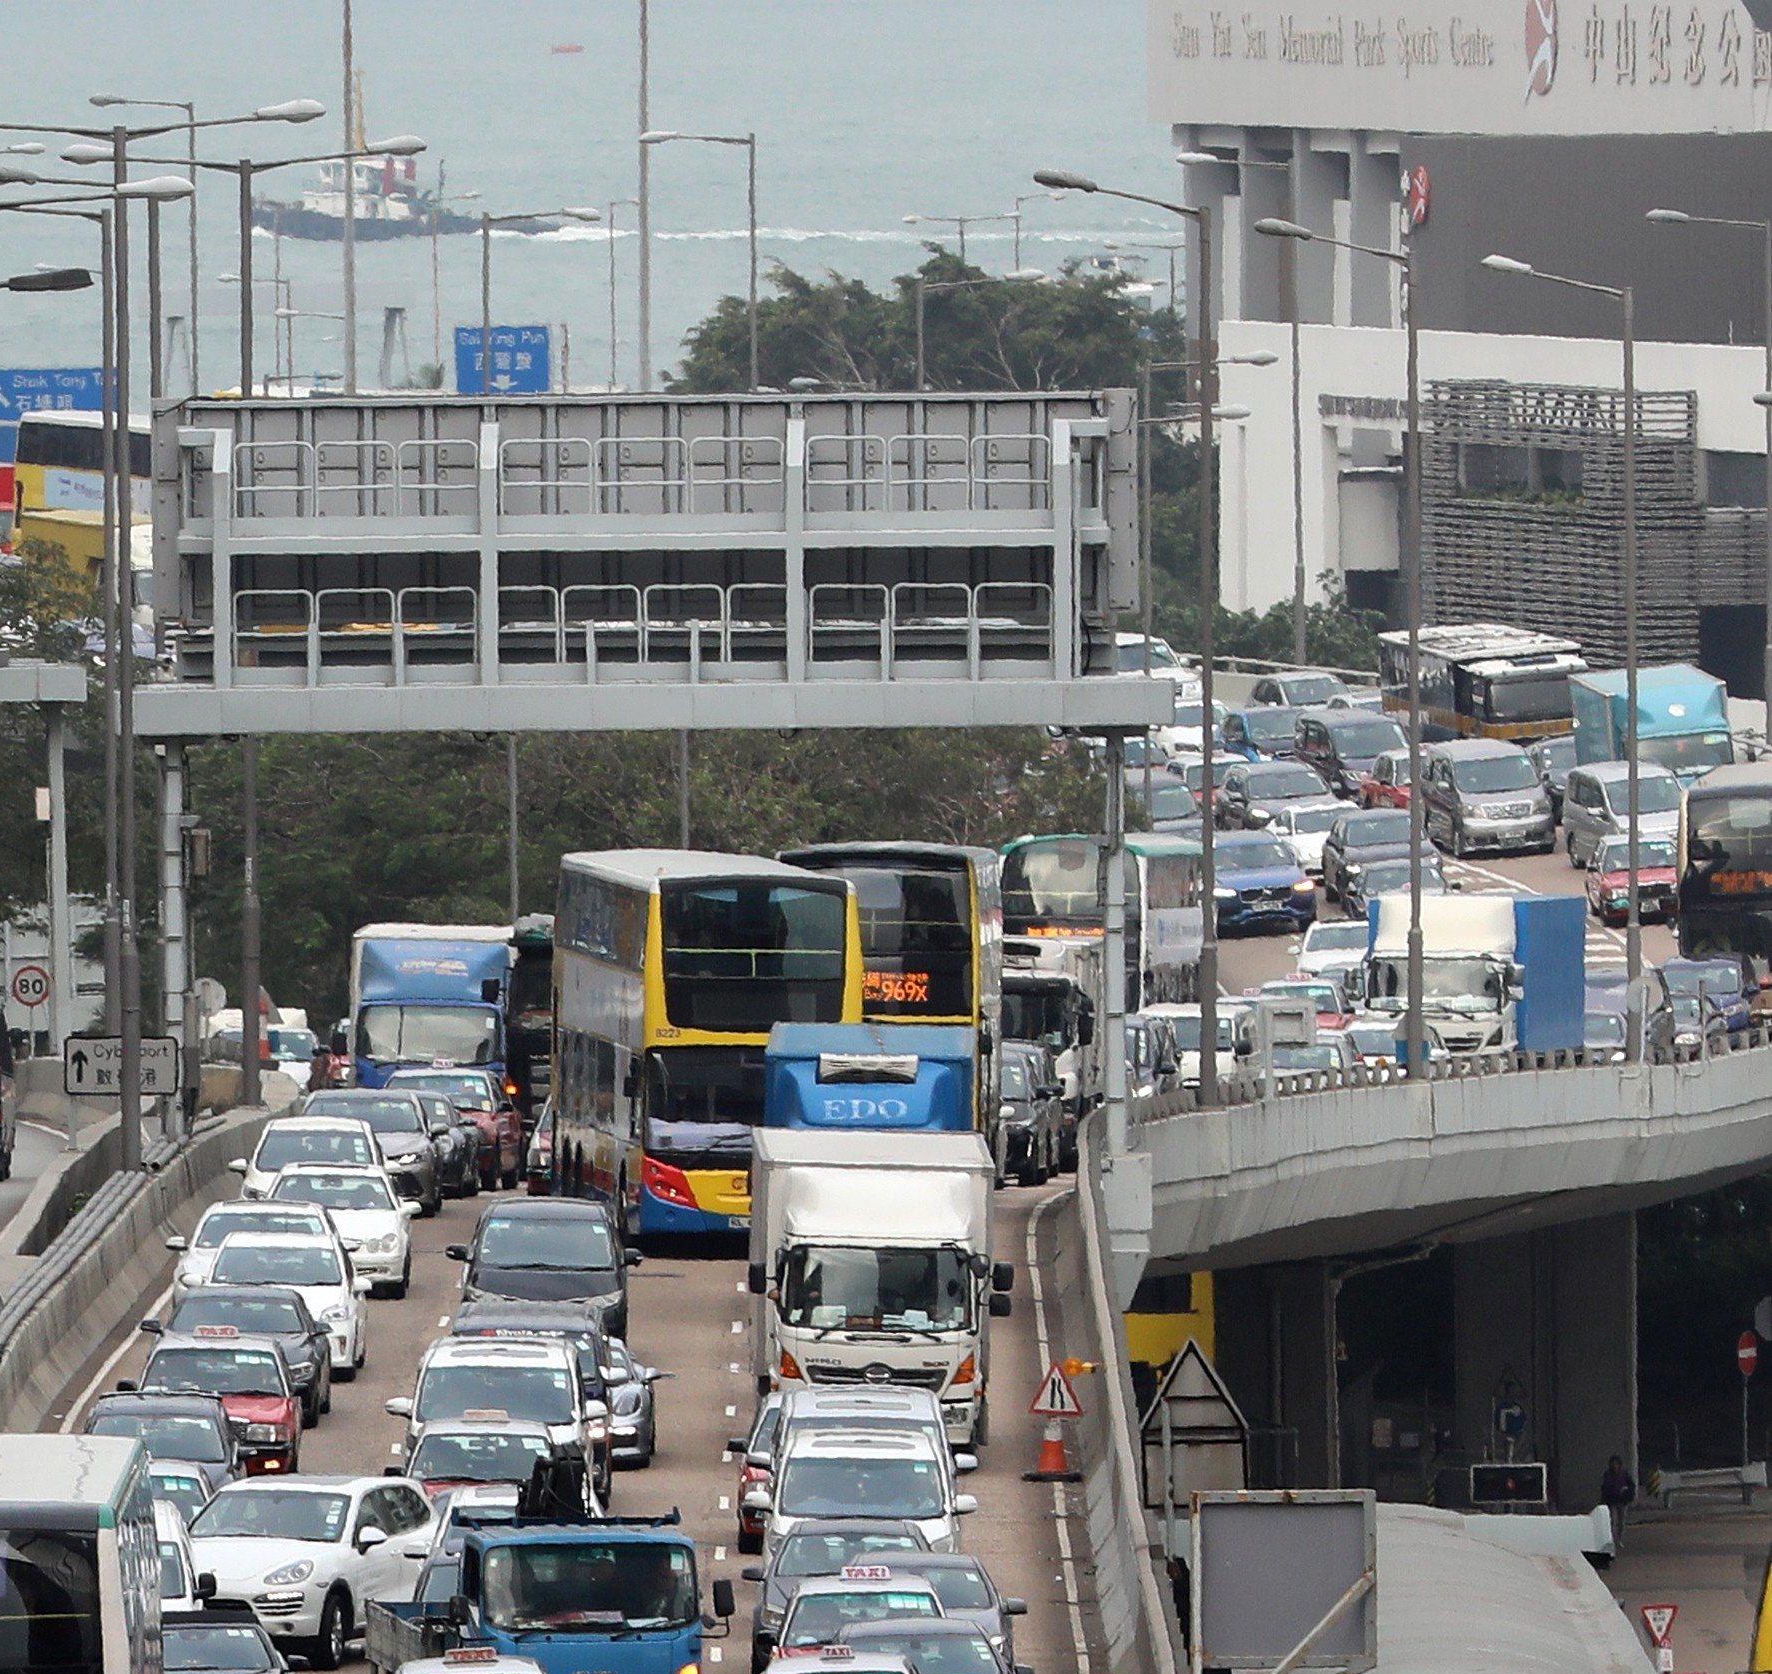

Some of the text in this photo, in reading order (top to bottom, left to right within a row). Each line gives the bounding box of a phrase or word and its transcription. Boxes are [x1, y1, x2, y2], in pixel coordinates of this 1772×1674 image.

[18, 978, 44, 995] 80
[822, 1098, 909, 1121] EDO
[845, 1568, 887, 1578] TAXI
[824, 1647, 850, 1657] TAXI
